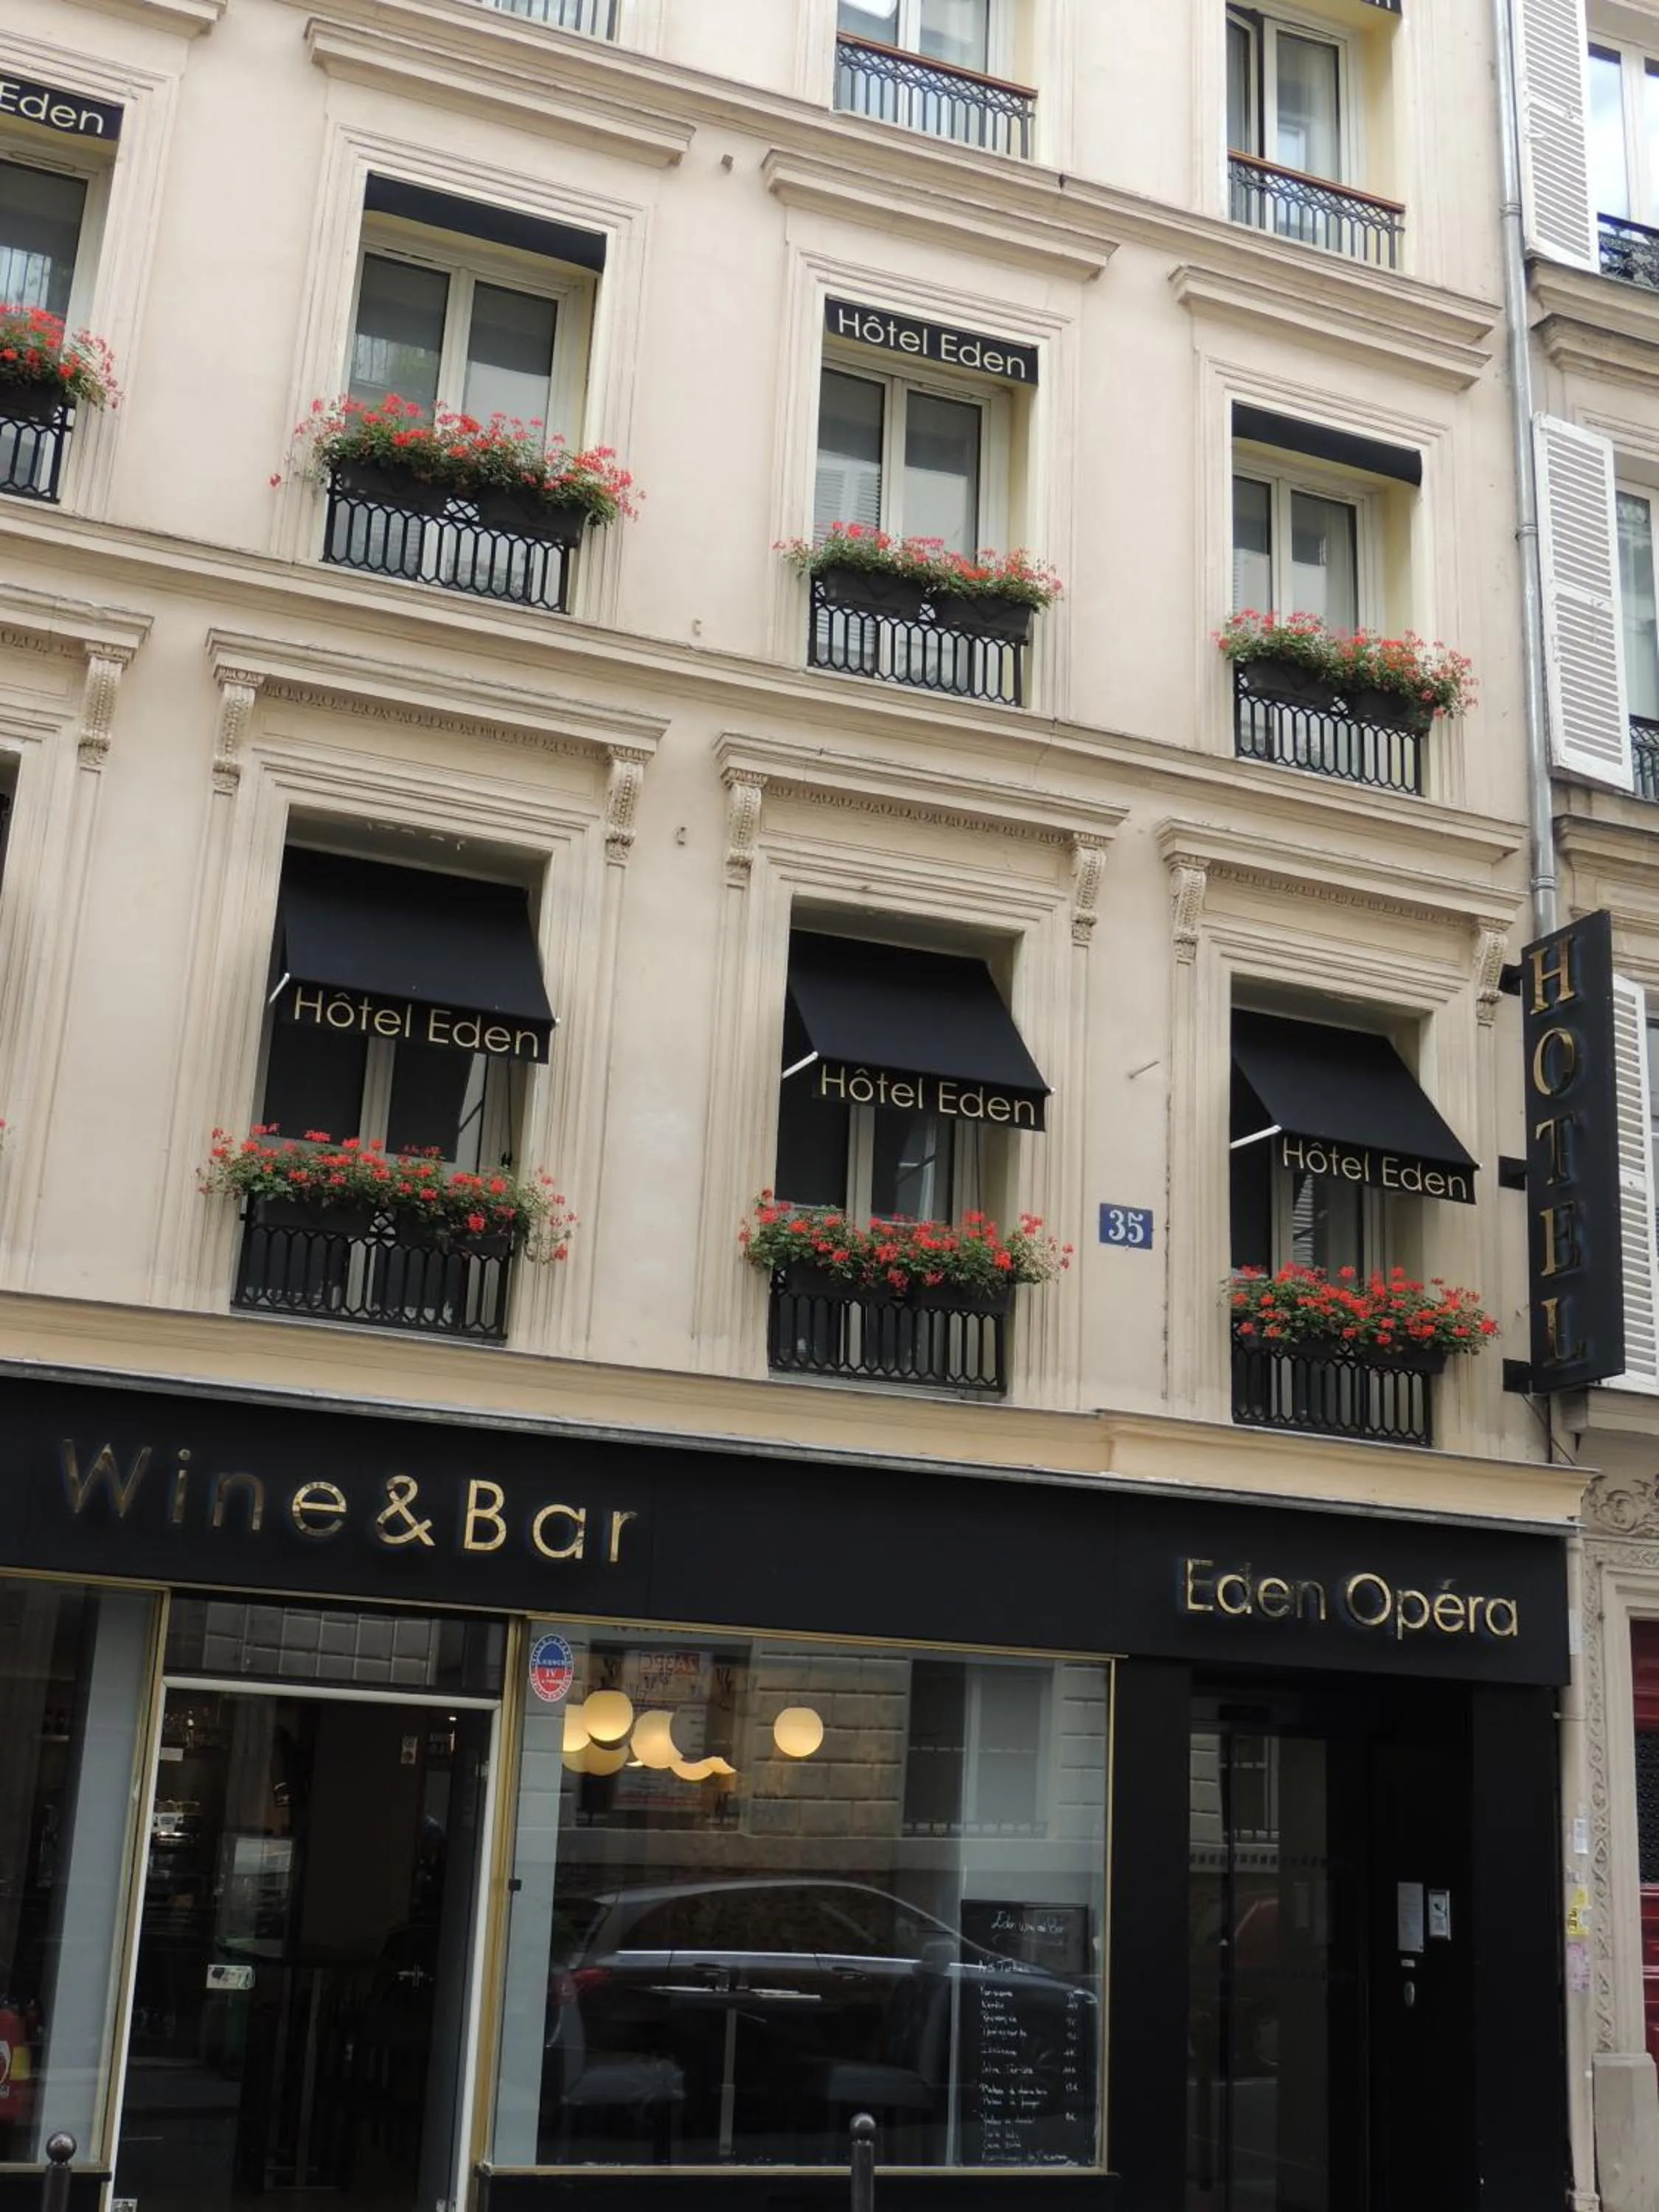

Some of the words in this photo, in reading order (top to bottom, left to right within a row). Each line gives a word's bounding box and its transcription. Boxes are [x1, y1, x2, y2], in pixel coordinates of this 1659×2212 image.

[0, 80, 105, 135] Eden
[838, 307, 928, 355] Hôtel
[940, 333, 1026, 378] Eden
[293, 985, 413, 1037] Hôtel
[428, 1008, 540, 1058] Eden
[821, 1064, 923, 1110] Hôtel
[938, 1081, 1035, 1126] Eden
[1282, 1136, 1370, 1183] Hôtel
[1382, 1155, 1467, 1200] Eden
[1528, 935, 1586, 1368] HOTEL
[1108, 1208, 1144, 1244] 35
[1186, 1557, 1327, 1621] Eden
[1346, 1572, 1519, 1641] Opéra
